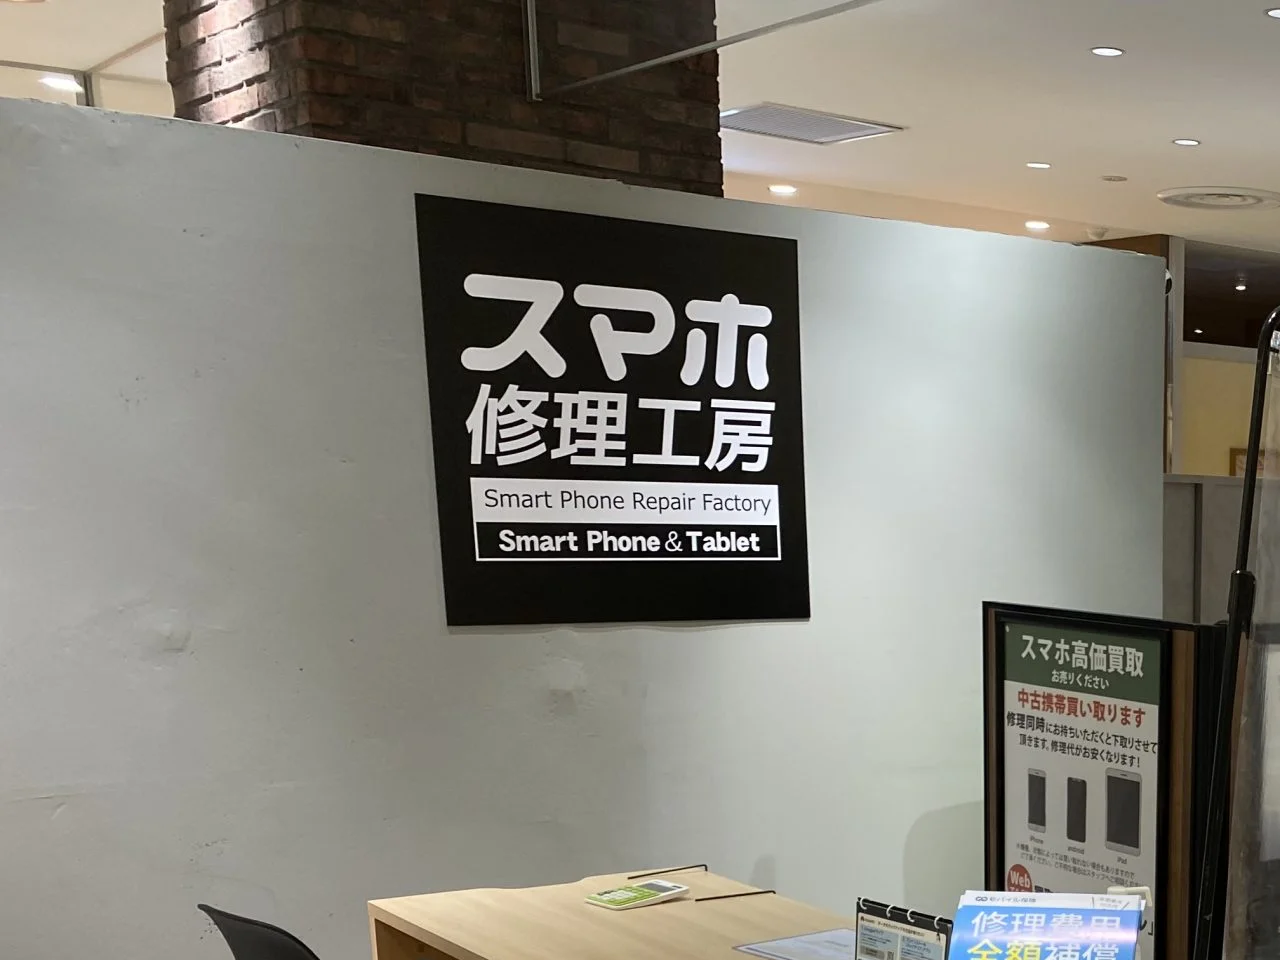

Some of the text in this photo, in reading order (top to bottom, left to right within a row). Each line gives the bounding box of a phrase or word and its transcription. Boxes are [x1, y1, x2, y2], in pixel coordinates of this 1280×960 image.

[460, 273, 773, 390] スマホ
[465, 384, 776, 472] 修理工房
[484, 488, 771, 516] Smart Phone Repair Factory
[499, 529, 578, 551] Smart
[587, 530, 660, 552] Phone
[686, 531, 760, 552] Tablet
[1021, 635, 1144, 678] スマホ高価買取
[1051, 669, 1110, 690] お売りください
[1018, 688, 1146, 728] 中古携帯買い取ります
[1006, 711, 1158, 754] 修理同時にお持ちいただくと下取りさせて
[1010, 870, 1031, 888] Web
[971, 911, 1121, 938] 修理費用
